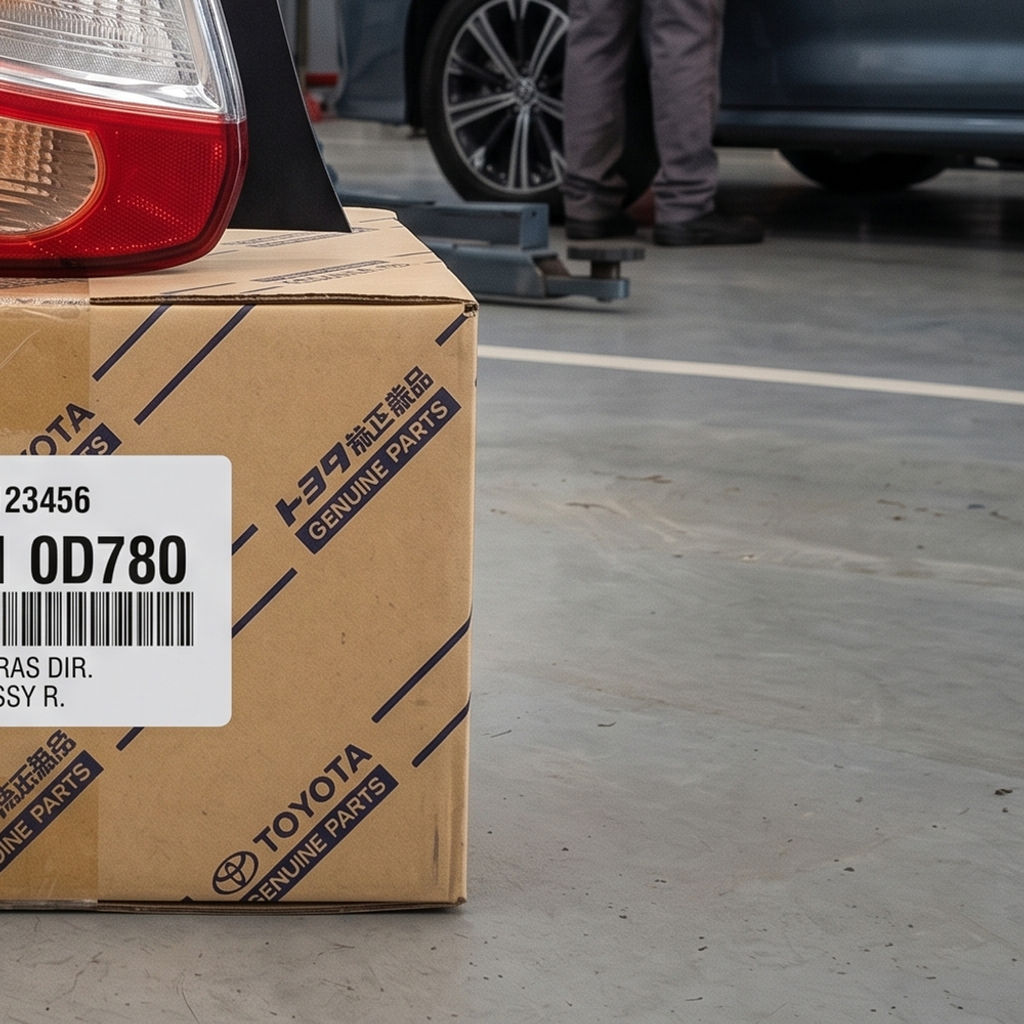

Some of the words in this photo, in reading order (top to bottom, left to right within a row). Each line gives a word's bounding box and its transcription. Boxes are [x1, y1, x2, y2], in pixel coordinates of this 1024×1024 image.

[20, 403, 95, 454] OTA
[308, 459, 389, 540] GENUINE
[386, 400, 448, 463] PARTS
[30, 534, 187, 585] 0D780
[48, 656, 93, 679] DIR.
[43, 684, 65, 708] R.
[29, 762, 91, 824] PARTS
[252, 743, 373, 852] TOYOTA
[324, 776, 386, 837] PARTS
